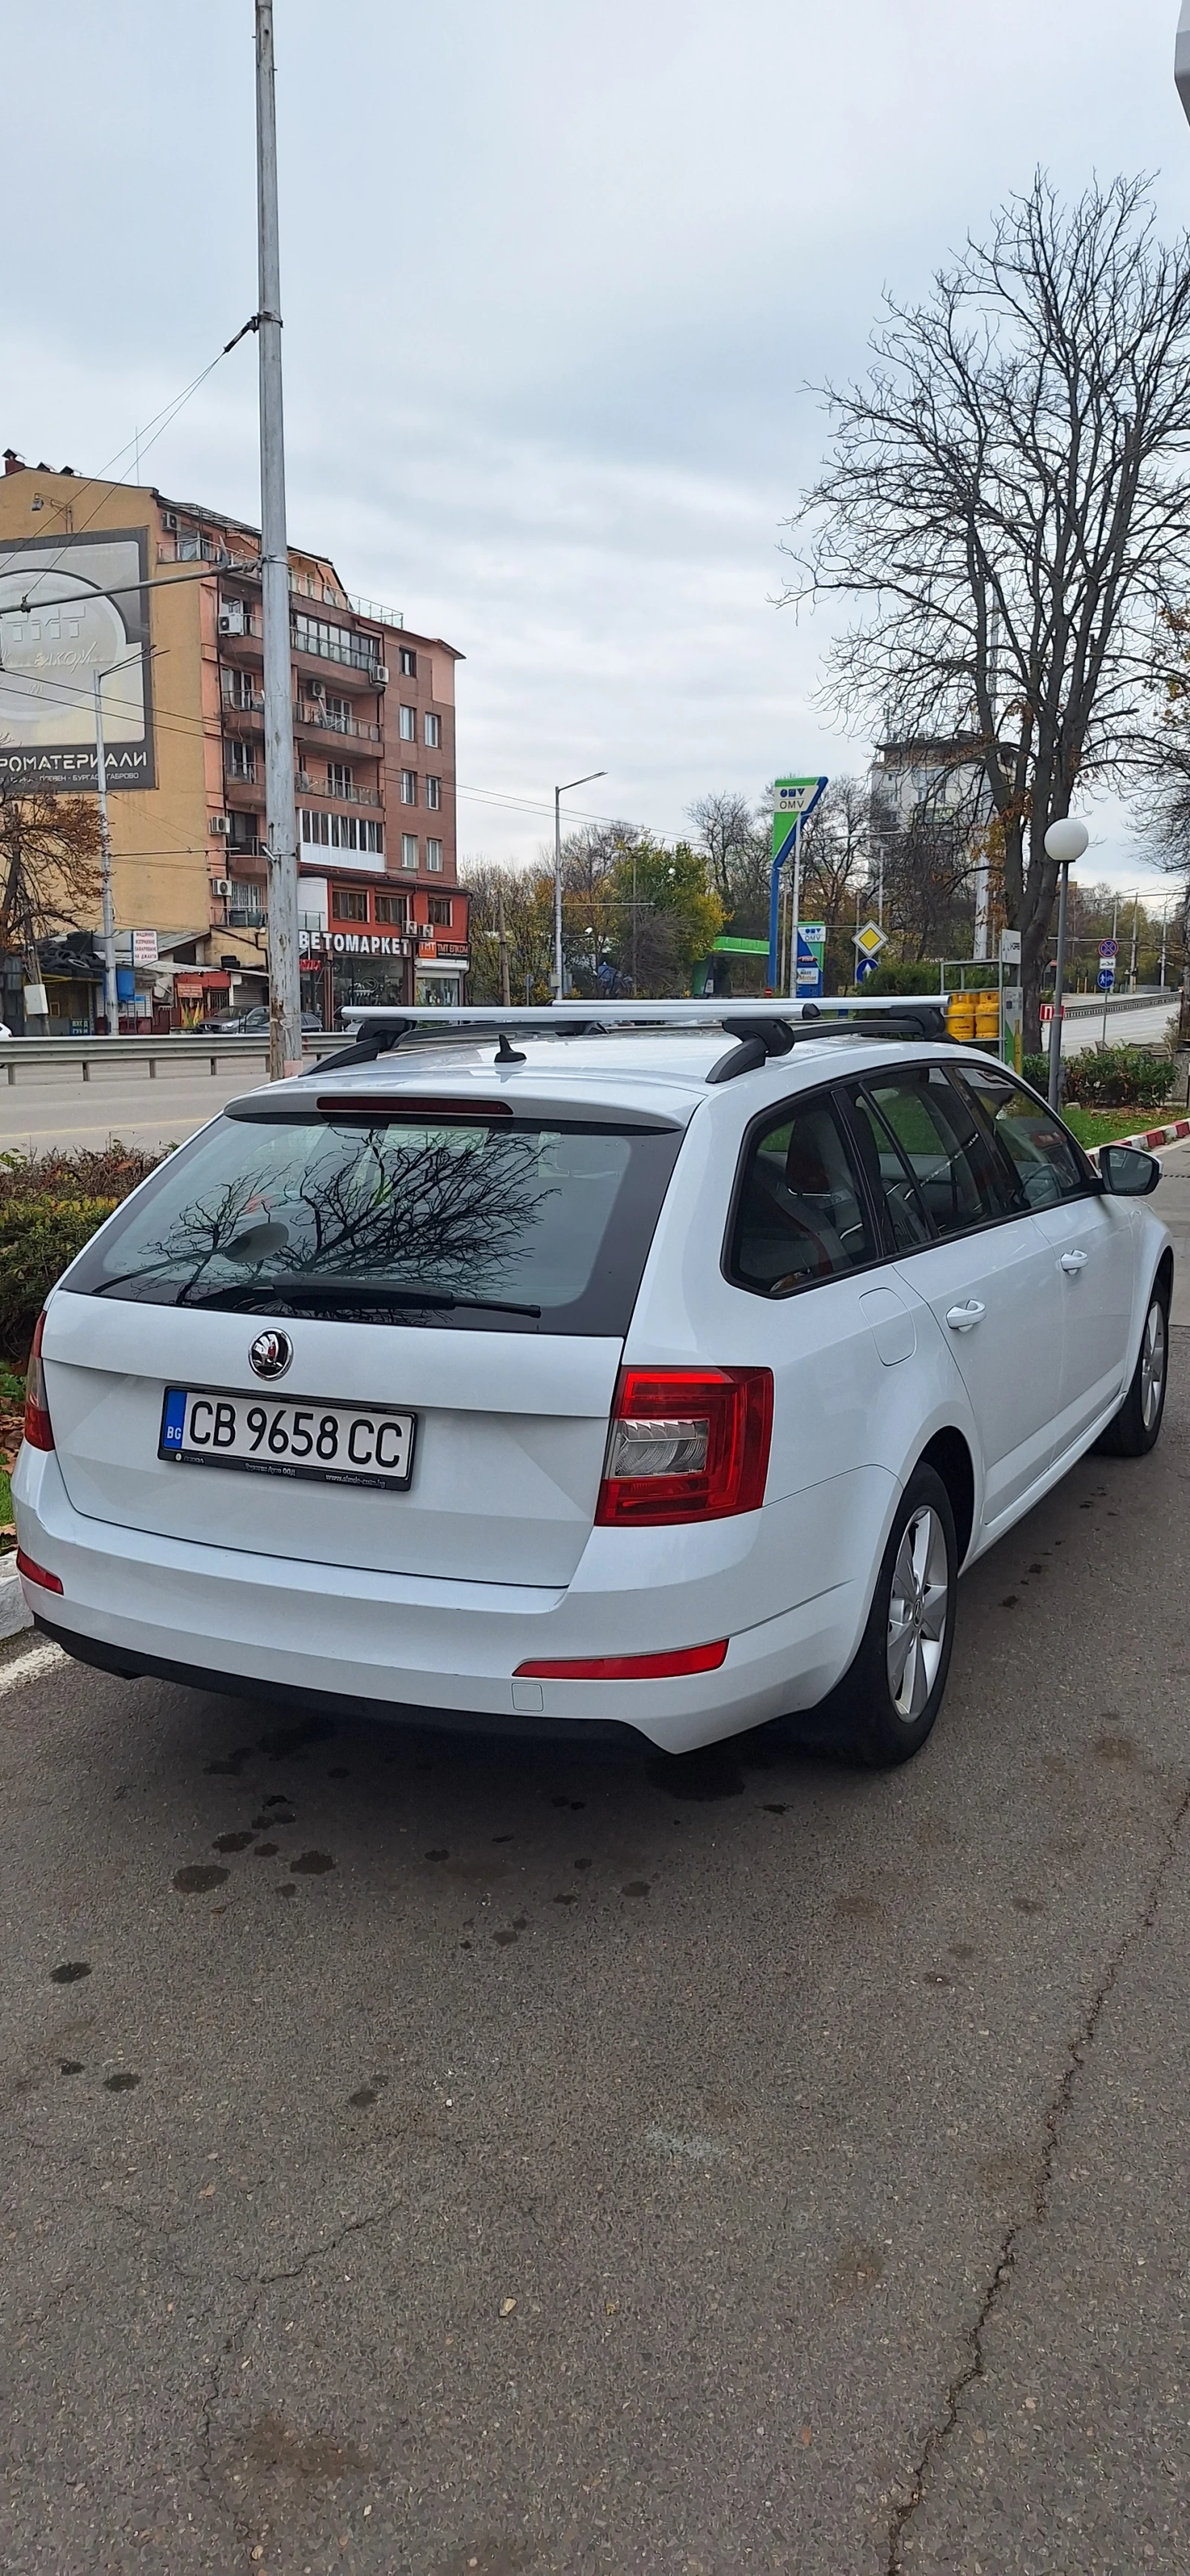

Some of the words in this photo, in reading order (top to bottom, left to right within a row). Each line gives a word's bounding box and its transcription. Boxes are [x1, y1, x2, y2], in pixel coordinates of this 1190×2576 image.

[779, 800, 804, 809] OMV
[167, 1426, 181, 1440] BG
[190, 1400, 236, 1447] CB
[246, 1407, 338, 1461] 9658
[348, 1419, 402, 1468] CC
